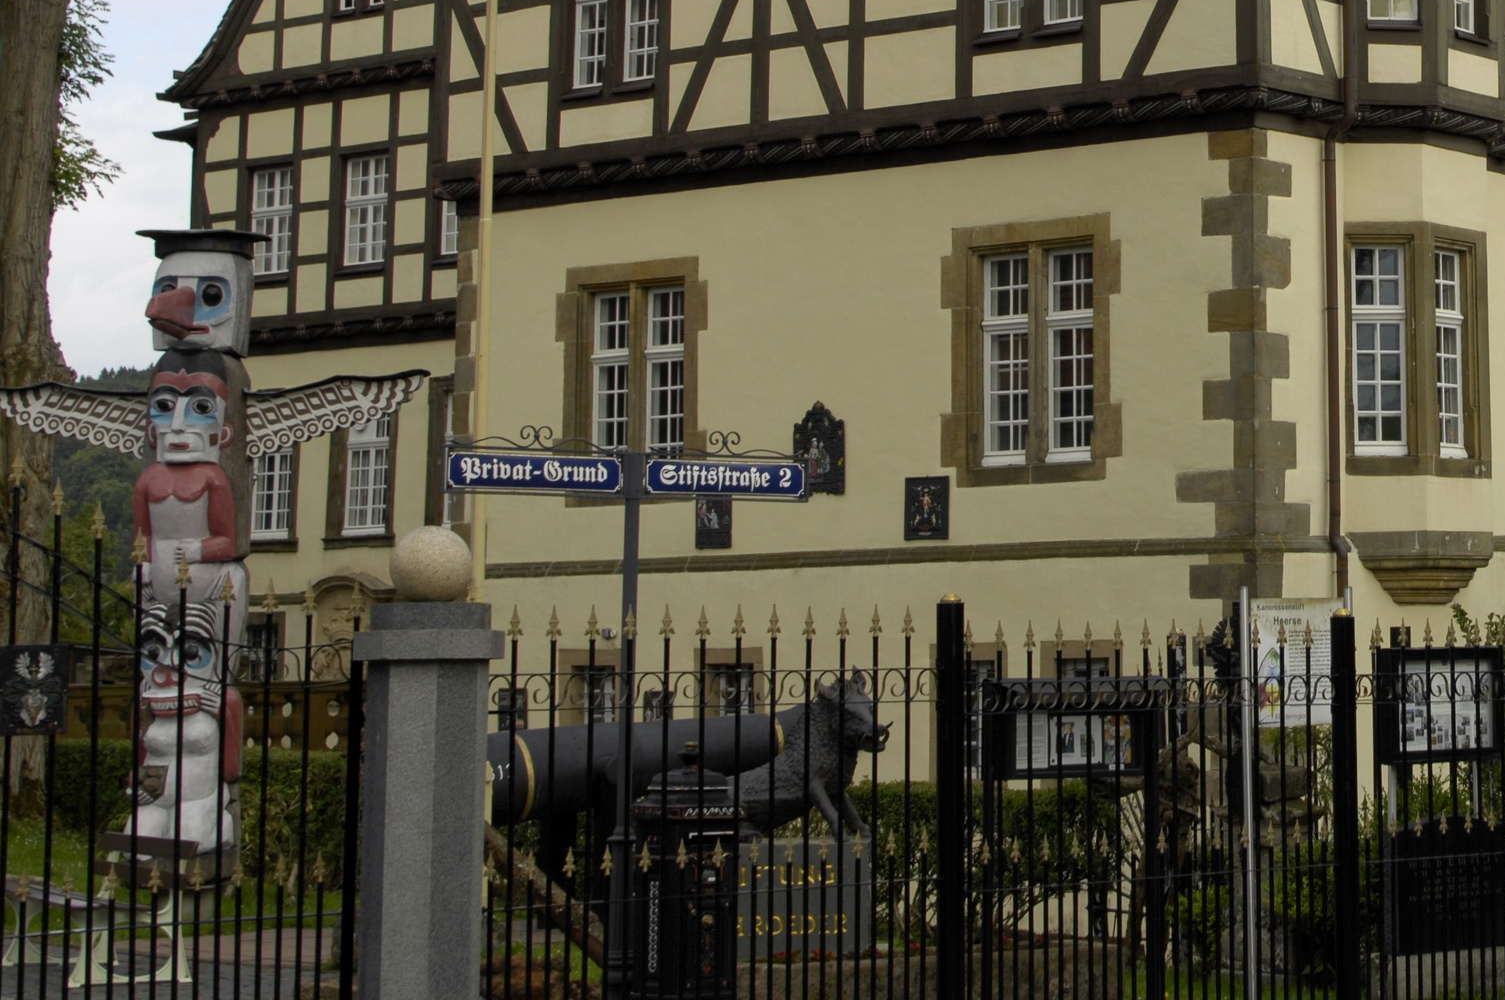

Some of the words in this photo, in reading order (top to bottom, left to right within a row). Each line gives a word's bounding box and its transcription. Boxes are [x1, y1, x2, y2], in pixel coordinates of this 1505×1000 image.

[460, 457, 608, 484] Privat-Grund
[779, 467, 792, 488] 2
[1273, 616, 1302, 626] Heerse
